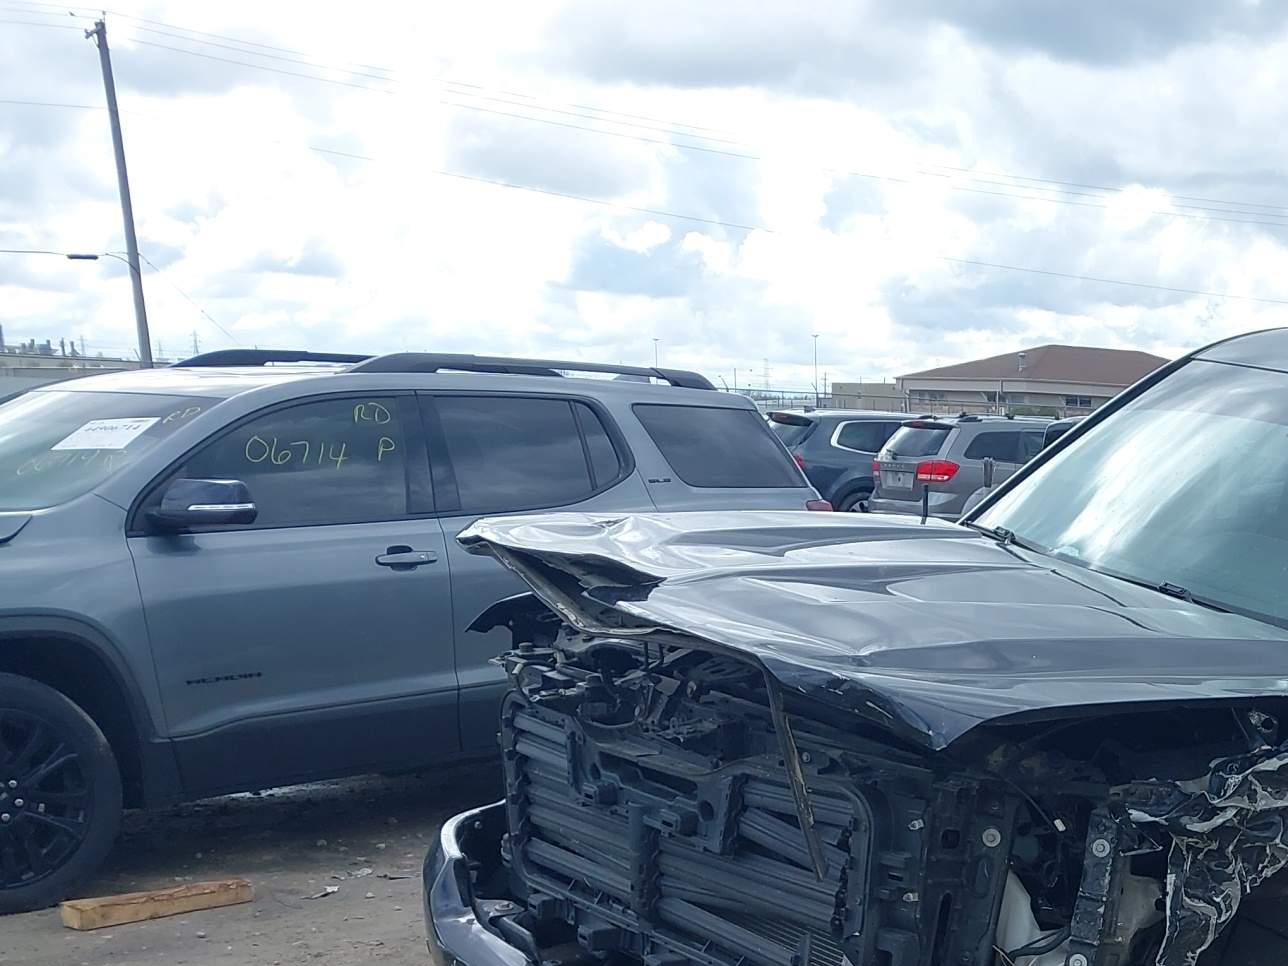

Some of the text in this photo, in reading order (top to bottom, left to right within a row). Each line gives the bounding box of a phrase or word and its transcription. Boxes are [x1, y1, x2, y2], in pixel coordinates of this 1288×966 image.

[353, 402, 391, 424] RD
[245, 435, 395, 470] 06714 P
